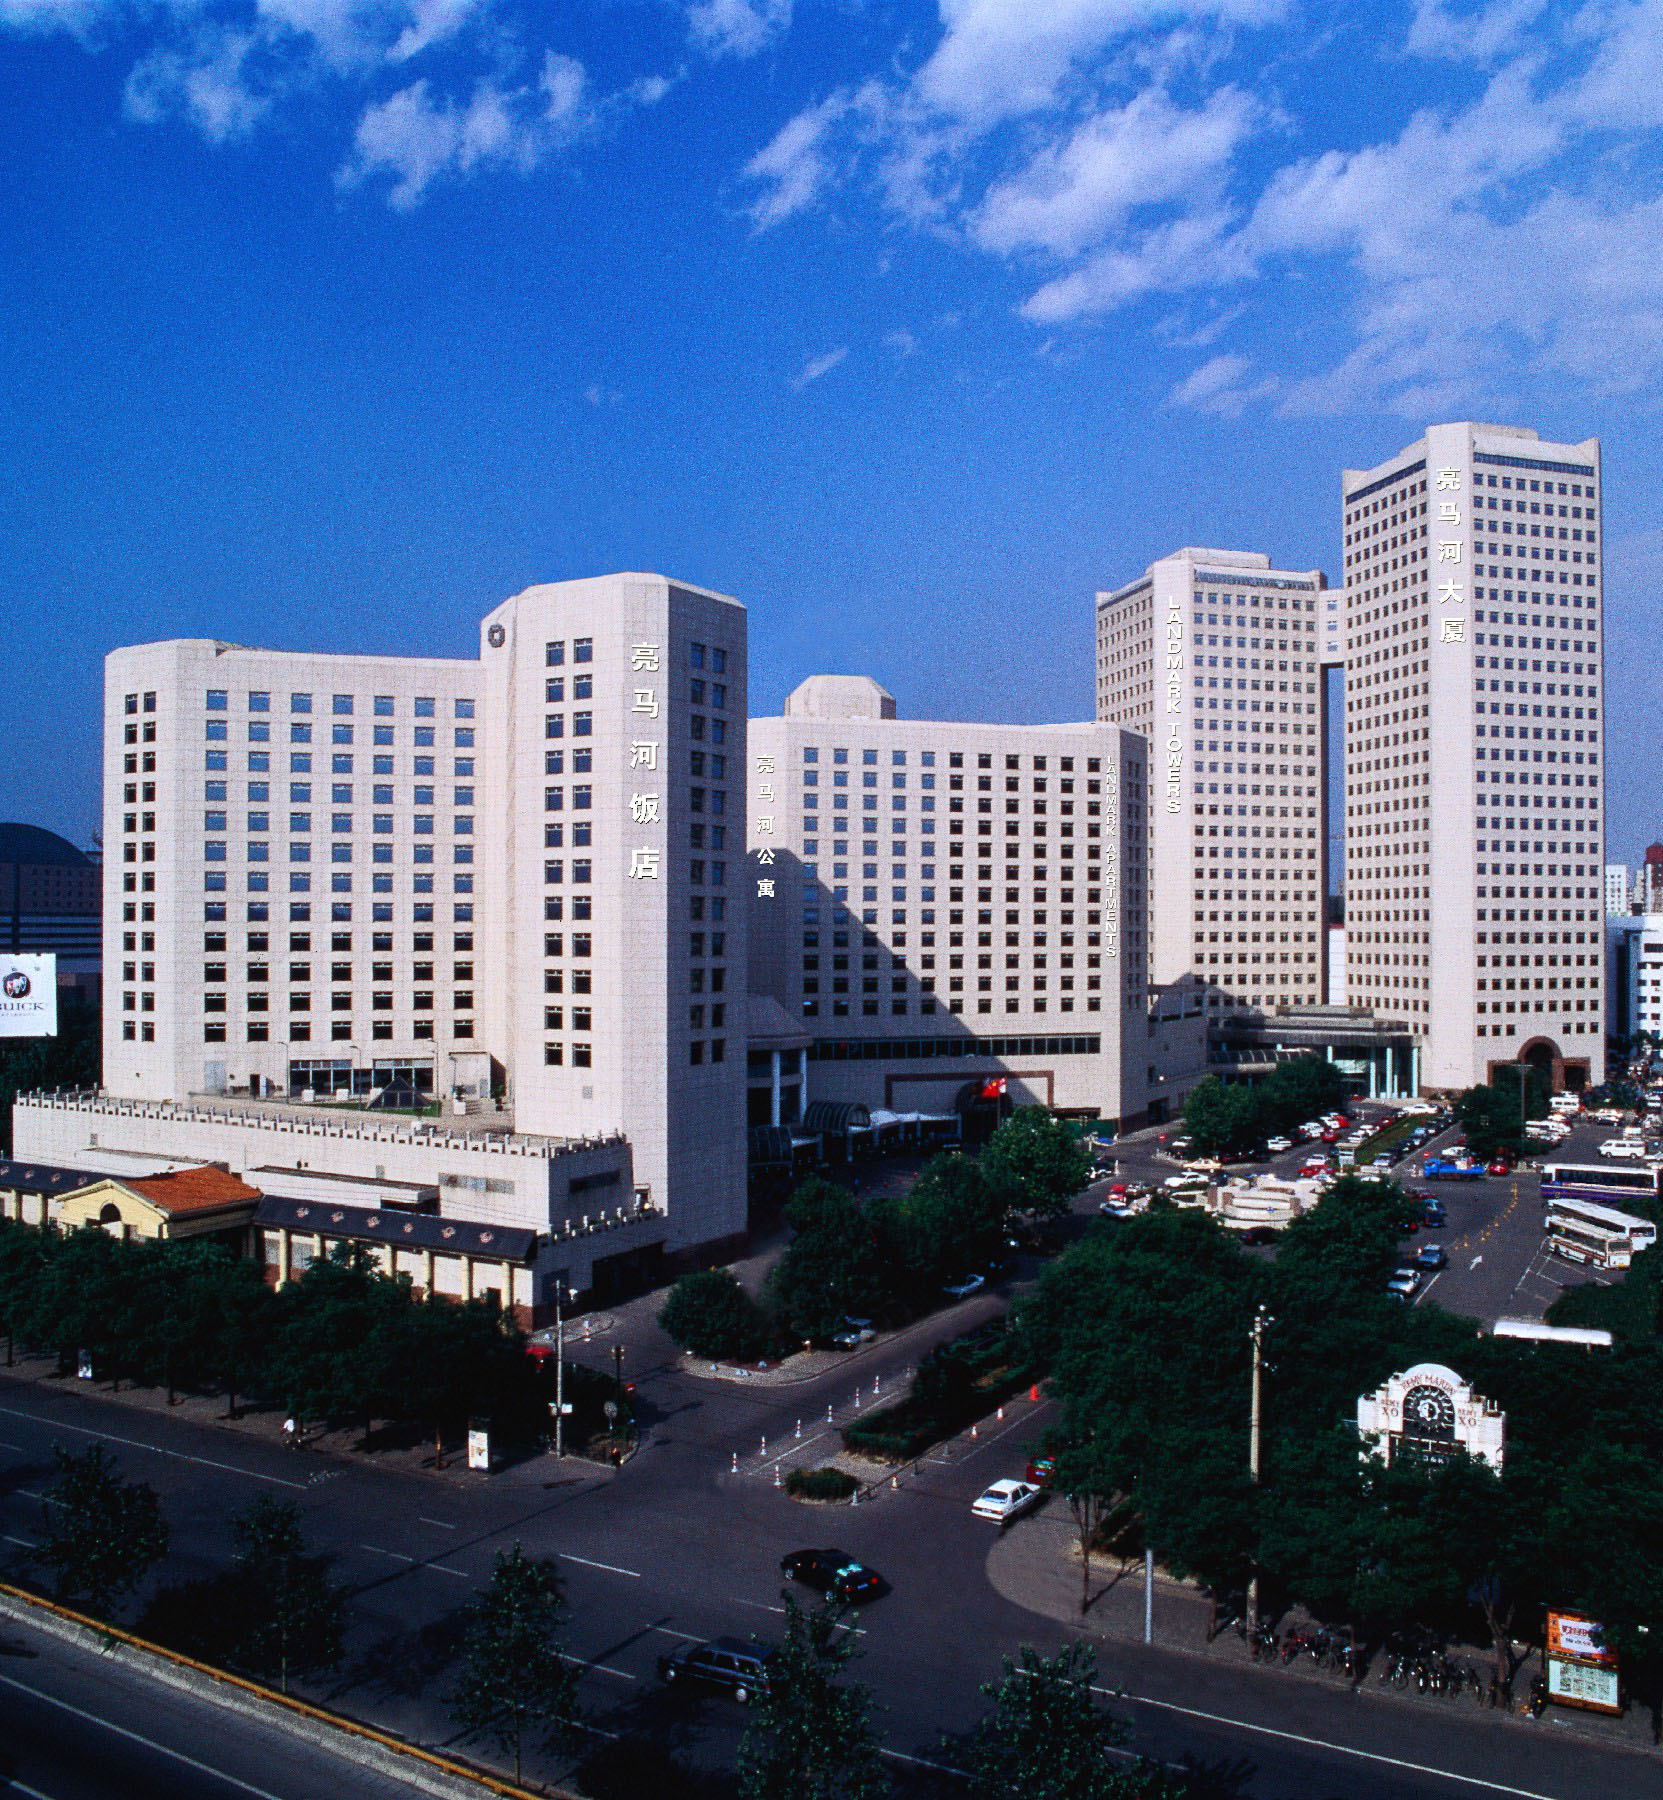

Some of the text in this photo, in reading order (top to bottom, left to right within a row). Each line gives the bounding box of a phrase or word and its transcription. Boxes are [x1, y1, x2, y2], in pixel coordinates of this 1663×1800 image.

[1436, 466, 1466, 643] 亮马河大厦
[628, 641, 660, 880] 亮马河饭店
[1166, 596, 1183, 814] LANDMARK TOWERS
[757, 754, 776, 898] 亮马河公寓
[1106, 756, 1117, 958] LANDMARK APARTMENTS
[0, 1002, 45, 1011] UICK
